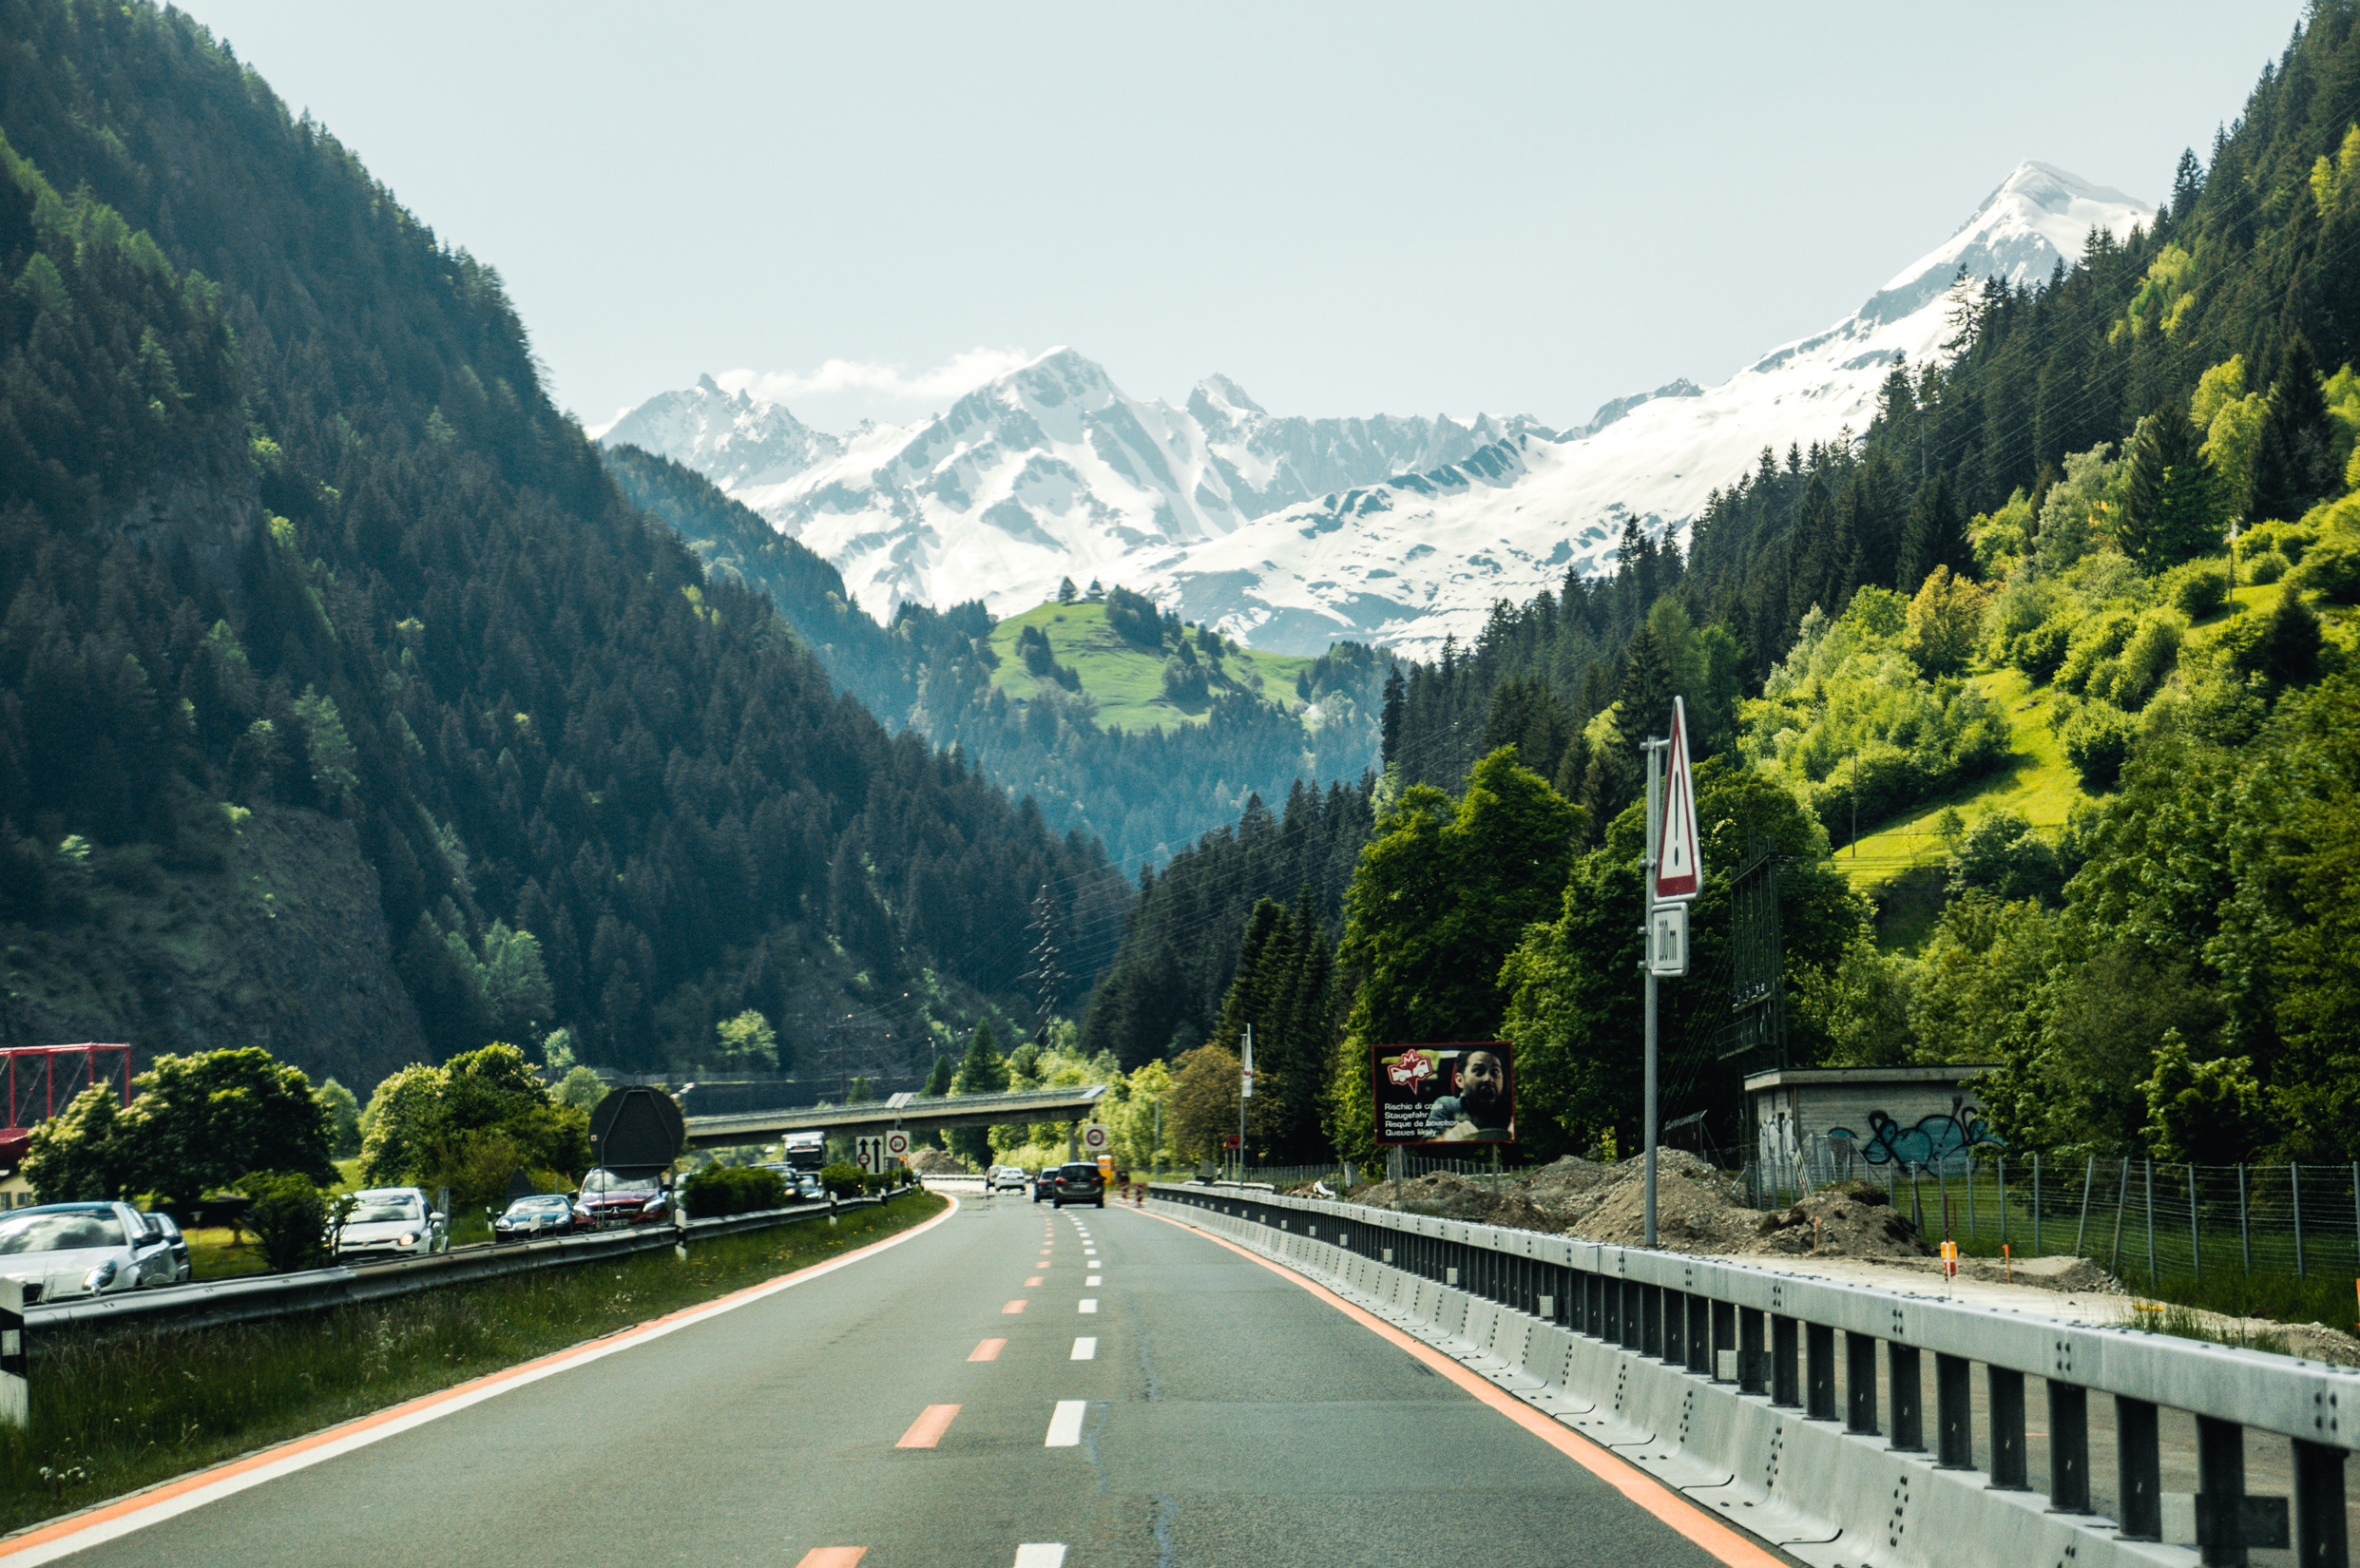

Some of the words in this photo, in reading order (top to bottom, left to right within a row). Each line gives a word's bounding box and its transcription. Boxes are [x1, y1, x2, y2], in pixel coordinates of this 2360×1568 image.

[1384, 1111, 1429, 1120] Staugefahr
[1385, 1119, 1412, 1128] Risque
[1417, 1128, 1437, 1137] likely
